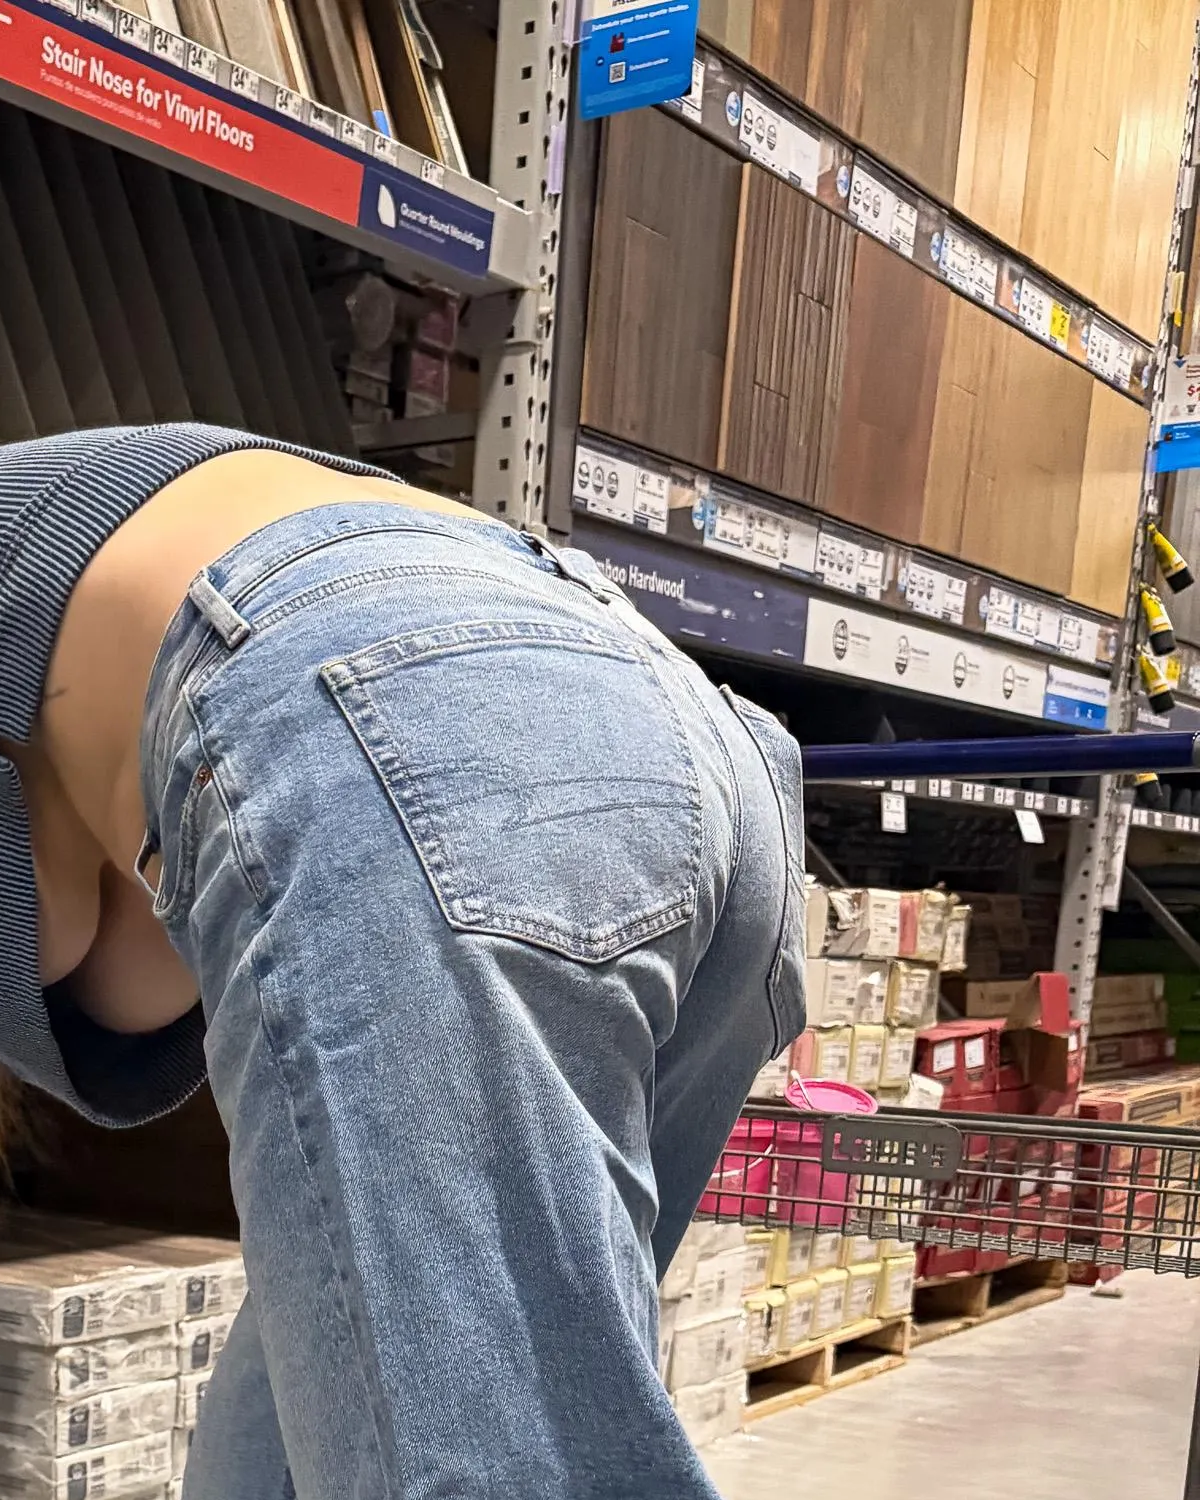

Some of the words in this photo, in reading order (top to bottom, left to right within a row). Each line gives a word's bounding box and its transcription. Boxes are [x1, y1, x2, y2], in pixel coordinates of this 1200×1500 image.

[41, 36, 87, 78] Stair
[89, 57, 133, 99] Nose
[136, 78, 162, 111] for
[164, 90, 205, 133] Vinyl
[206, 108, 255, 152] Floors
[629, 565, 685, 600] Hardwood
